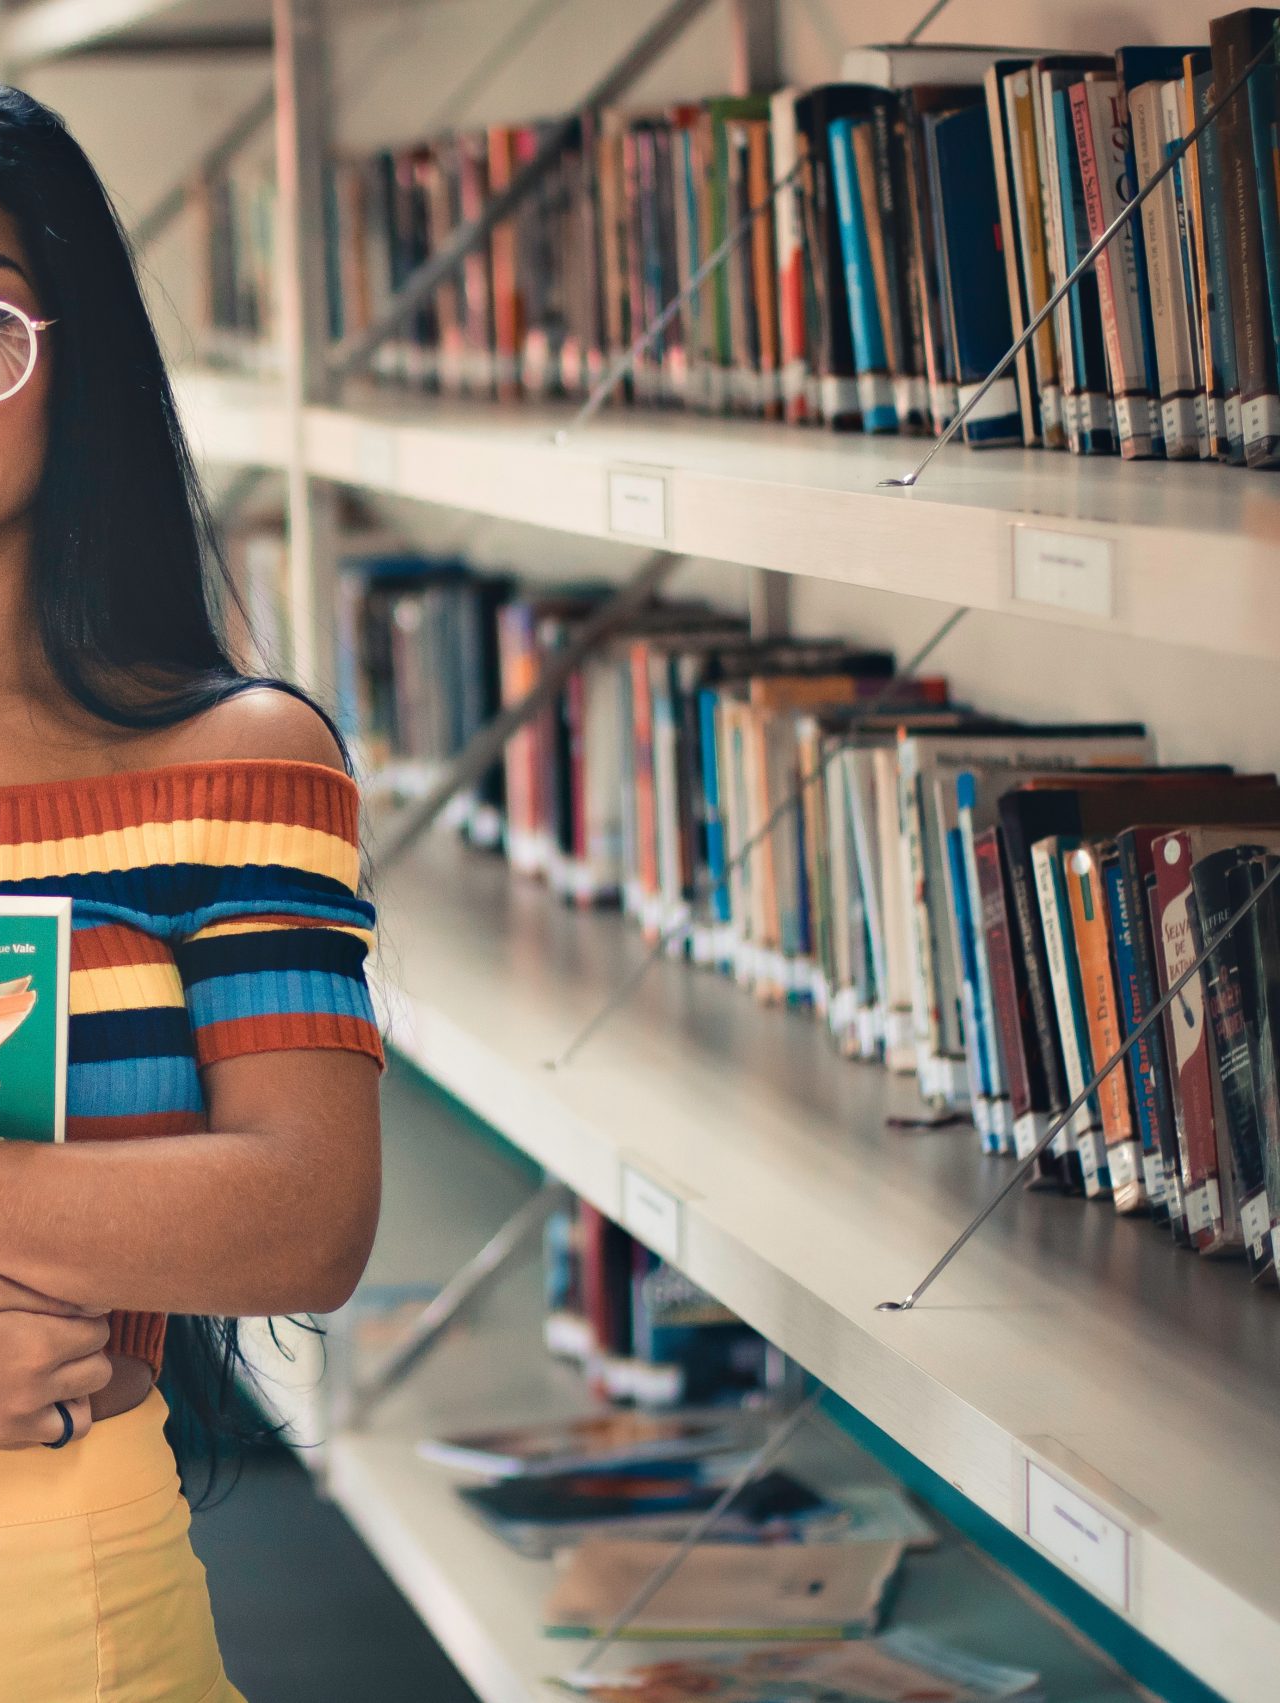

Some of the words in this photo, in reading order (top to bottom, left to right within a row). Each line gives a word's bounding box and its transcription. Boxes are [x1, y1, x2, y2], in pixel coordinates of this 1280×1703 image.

[1072, 99, 1093, 174] Fernando
[1083, 174, 1099, 232] Sabino
[12, 944, 36, 953] Vale
